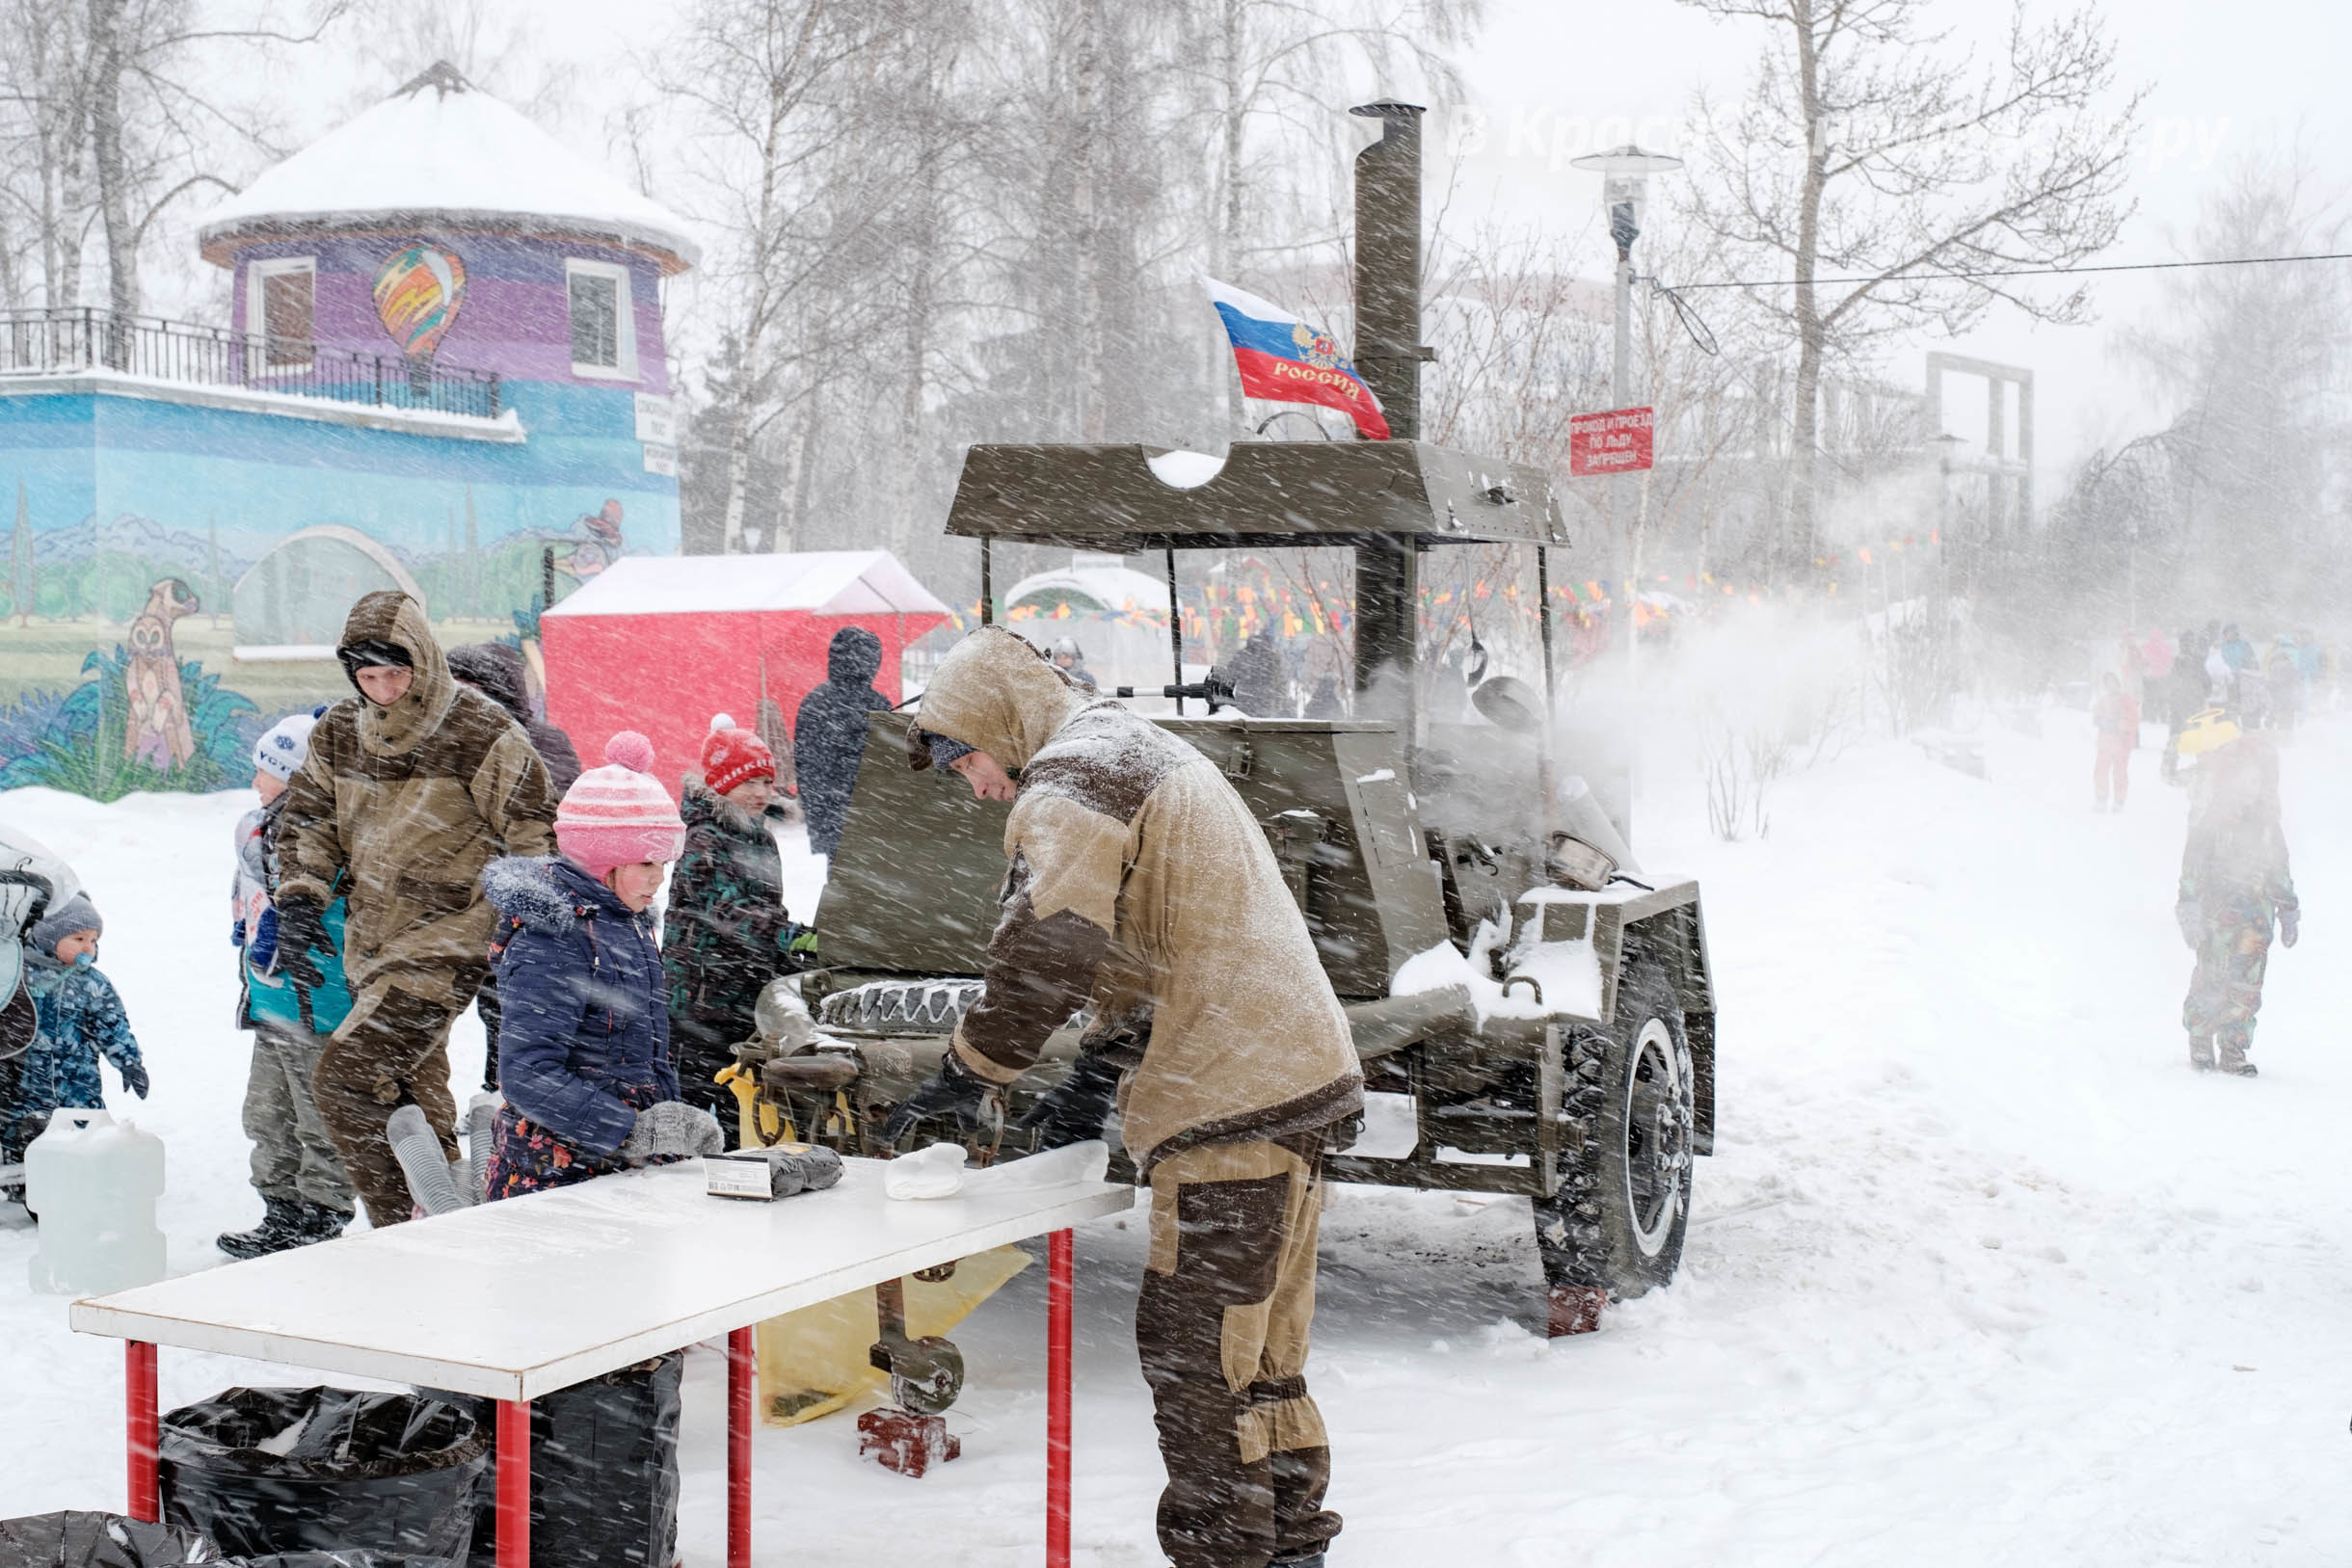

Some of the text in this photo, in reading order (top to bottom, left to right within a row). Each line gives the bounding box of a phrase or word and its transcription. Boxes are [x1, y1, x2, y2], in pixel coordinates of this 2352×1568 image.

[1273, 362, 1361, 401] РОССИЯ
[1571, 412, 1653, 434] ПРОХОД И ПРОЕЗД
[1590, 436, 1603, 449] ПО
